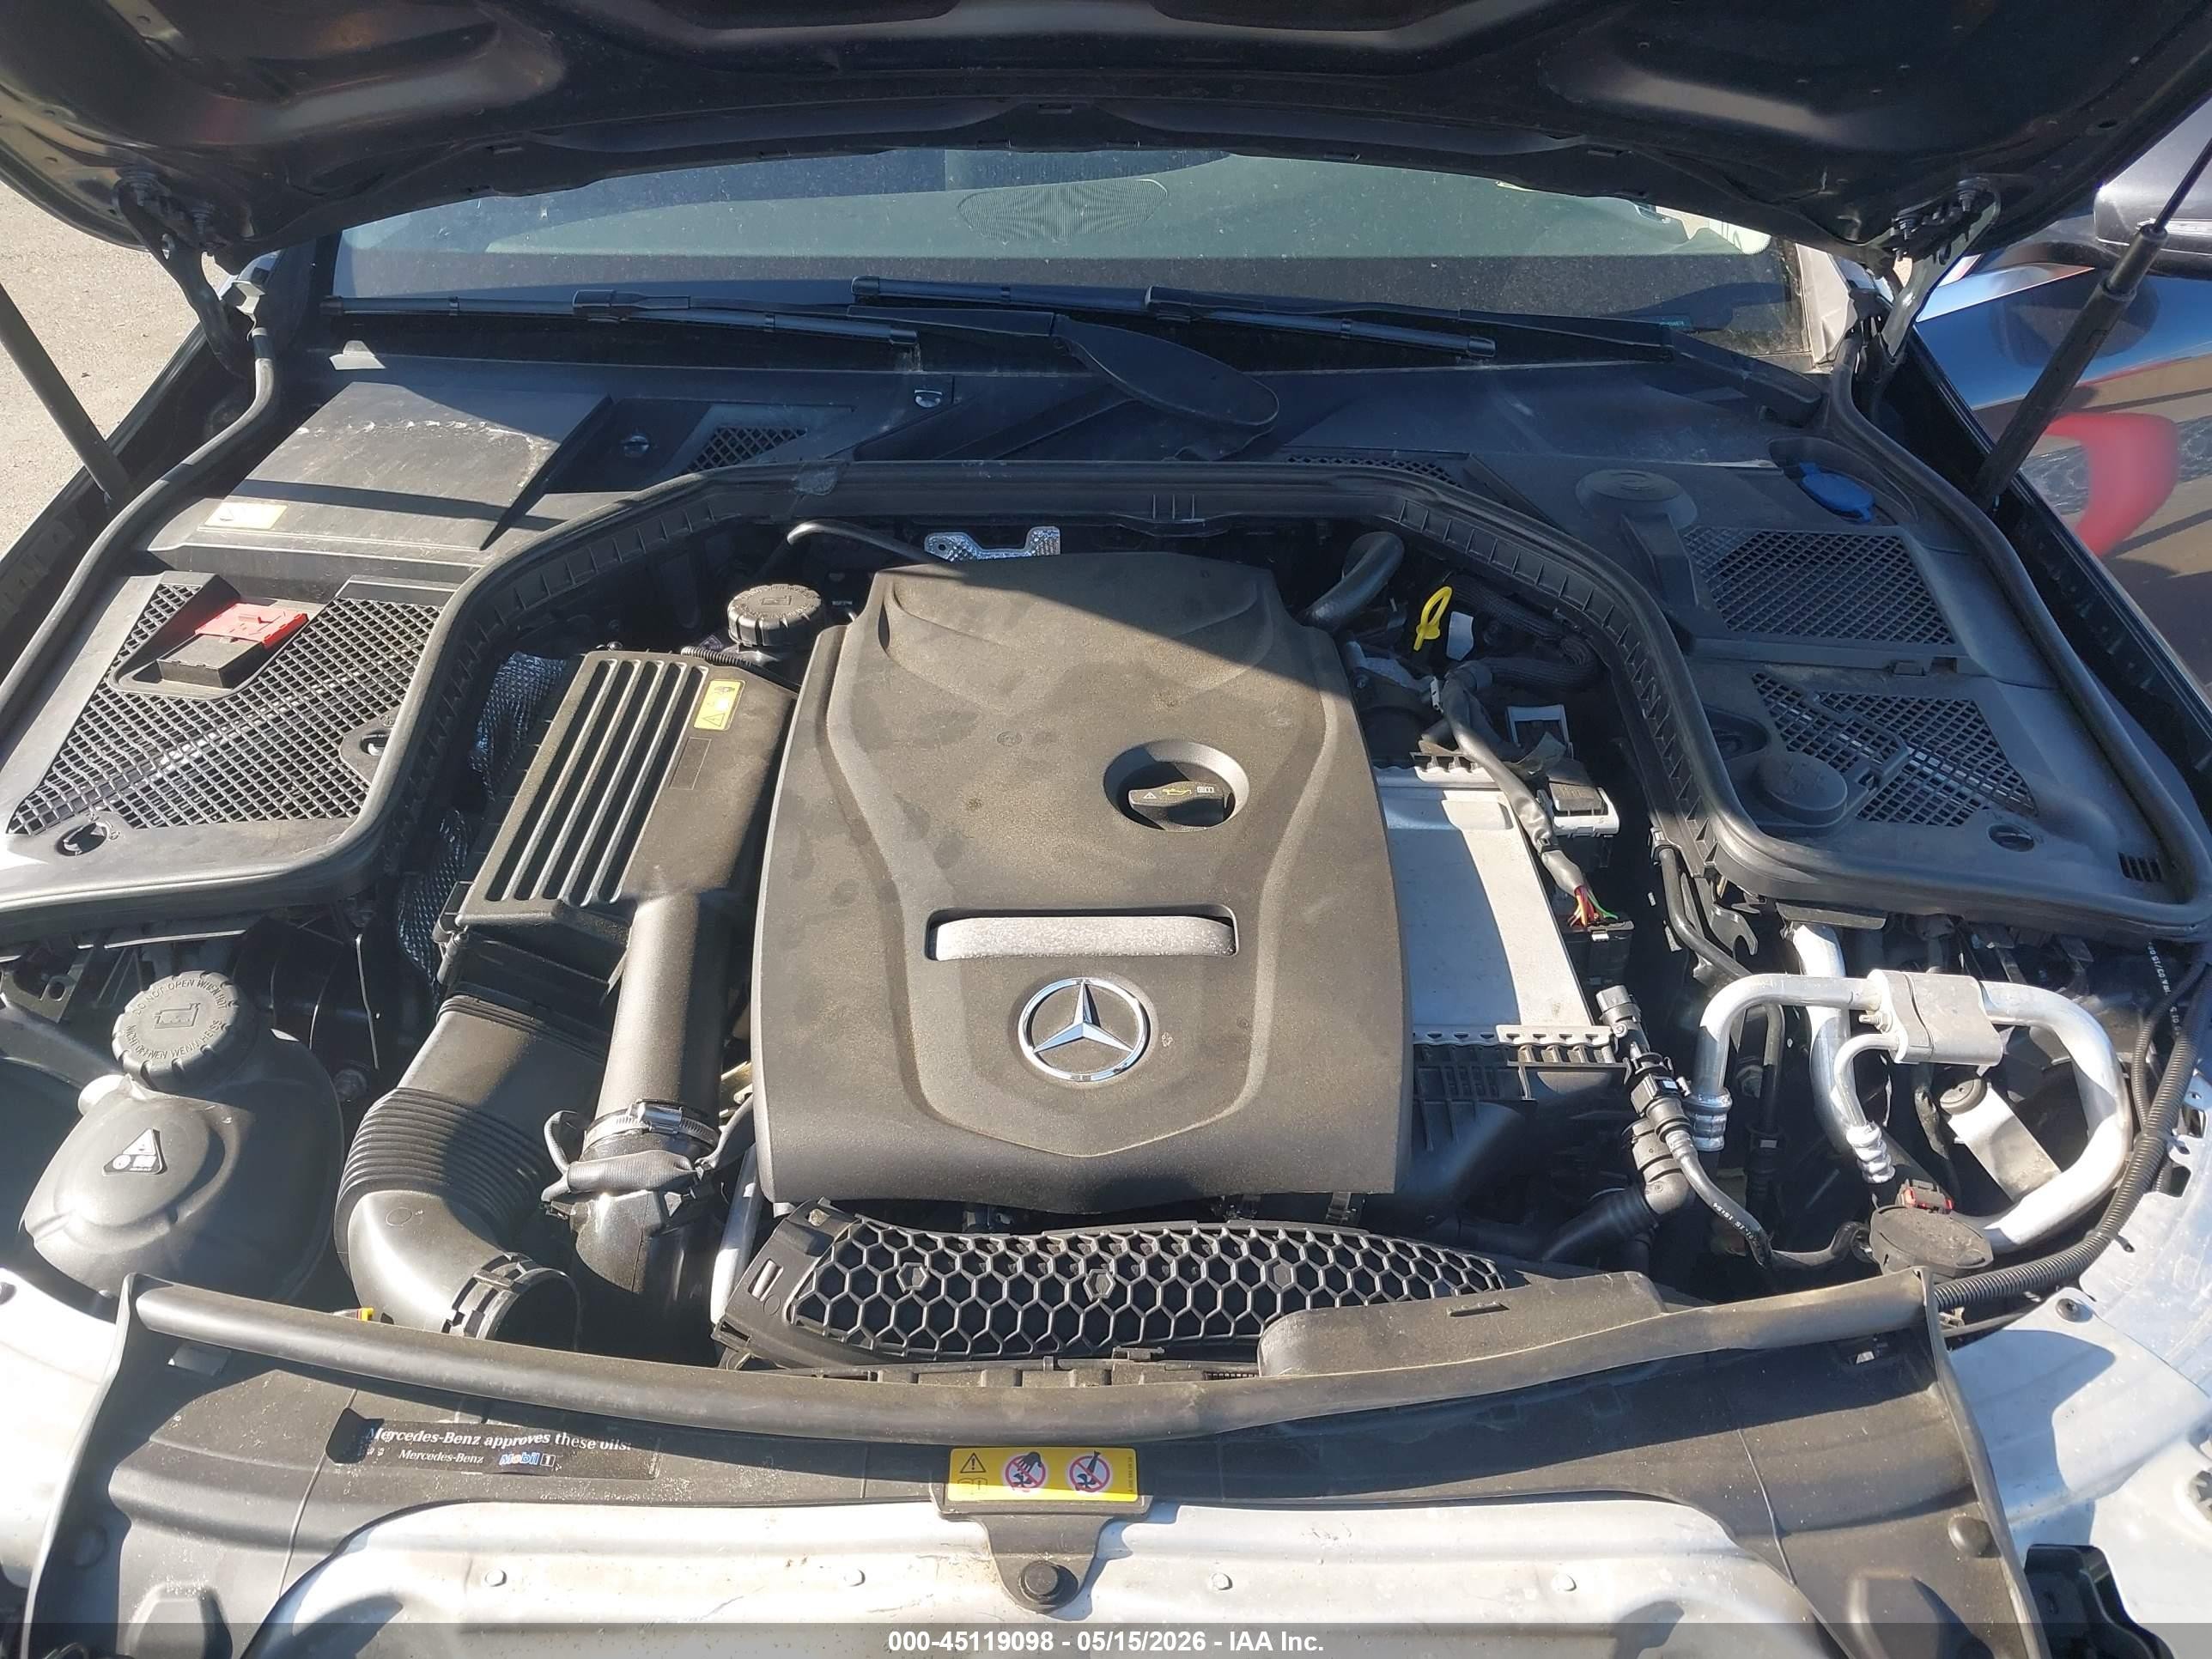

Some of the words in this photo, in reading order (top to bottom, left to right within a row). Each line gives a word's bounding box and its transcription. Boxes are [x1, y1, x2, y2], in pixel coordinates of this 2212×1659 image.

[132, 1003, 146, 1017] DO
[147, 987, 164, 1002] NOT
[167, 979, 195, 990] OPEN
[197, 979, 220, 996] WHEN
[216, 994, 228, 1009] HOT
[171, 1041, 199, 1058] WENN
[365, 1427, 482, 1446] Mercedes-Benz
[484, 1433, 551, 1449] approves
[555, 1431, 596, 1449] these
[398, 1449, 484, 1464] Mercedes-Benz
[499, 1452, 540, 1466] Mobil
